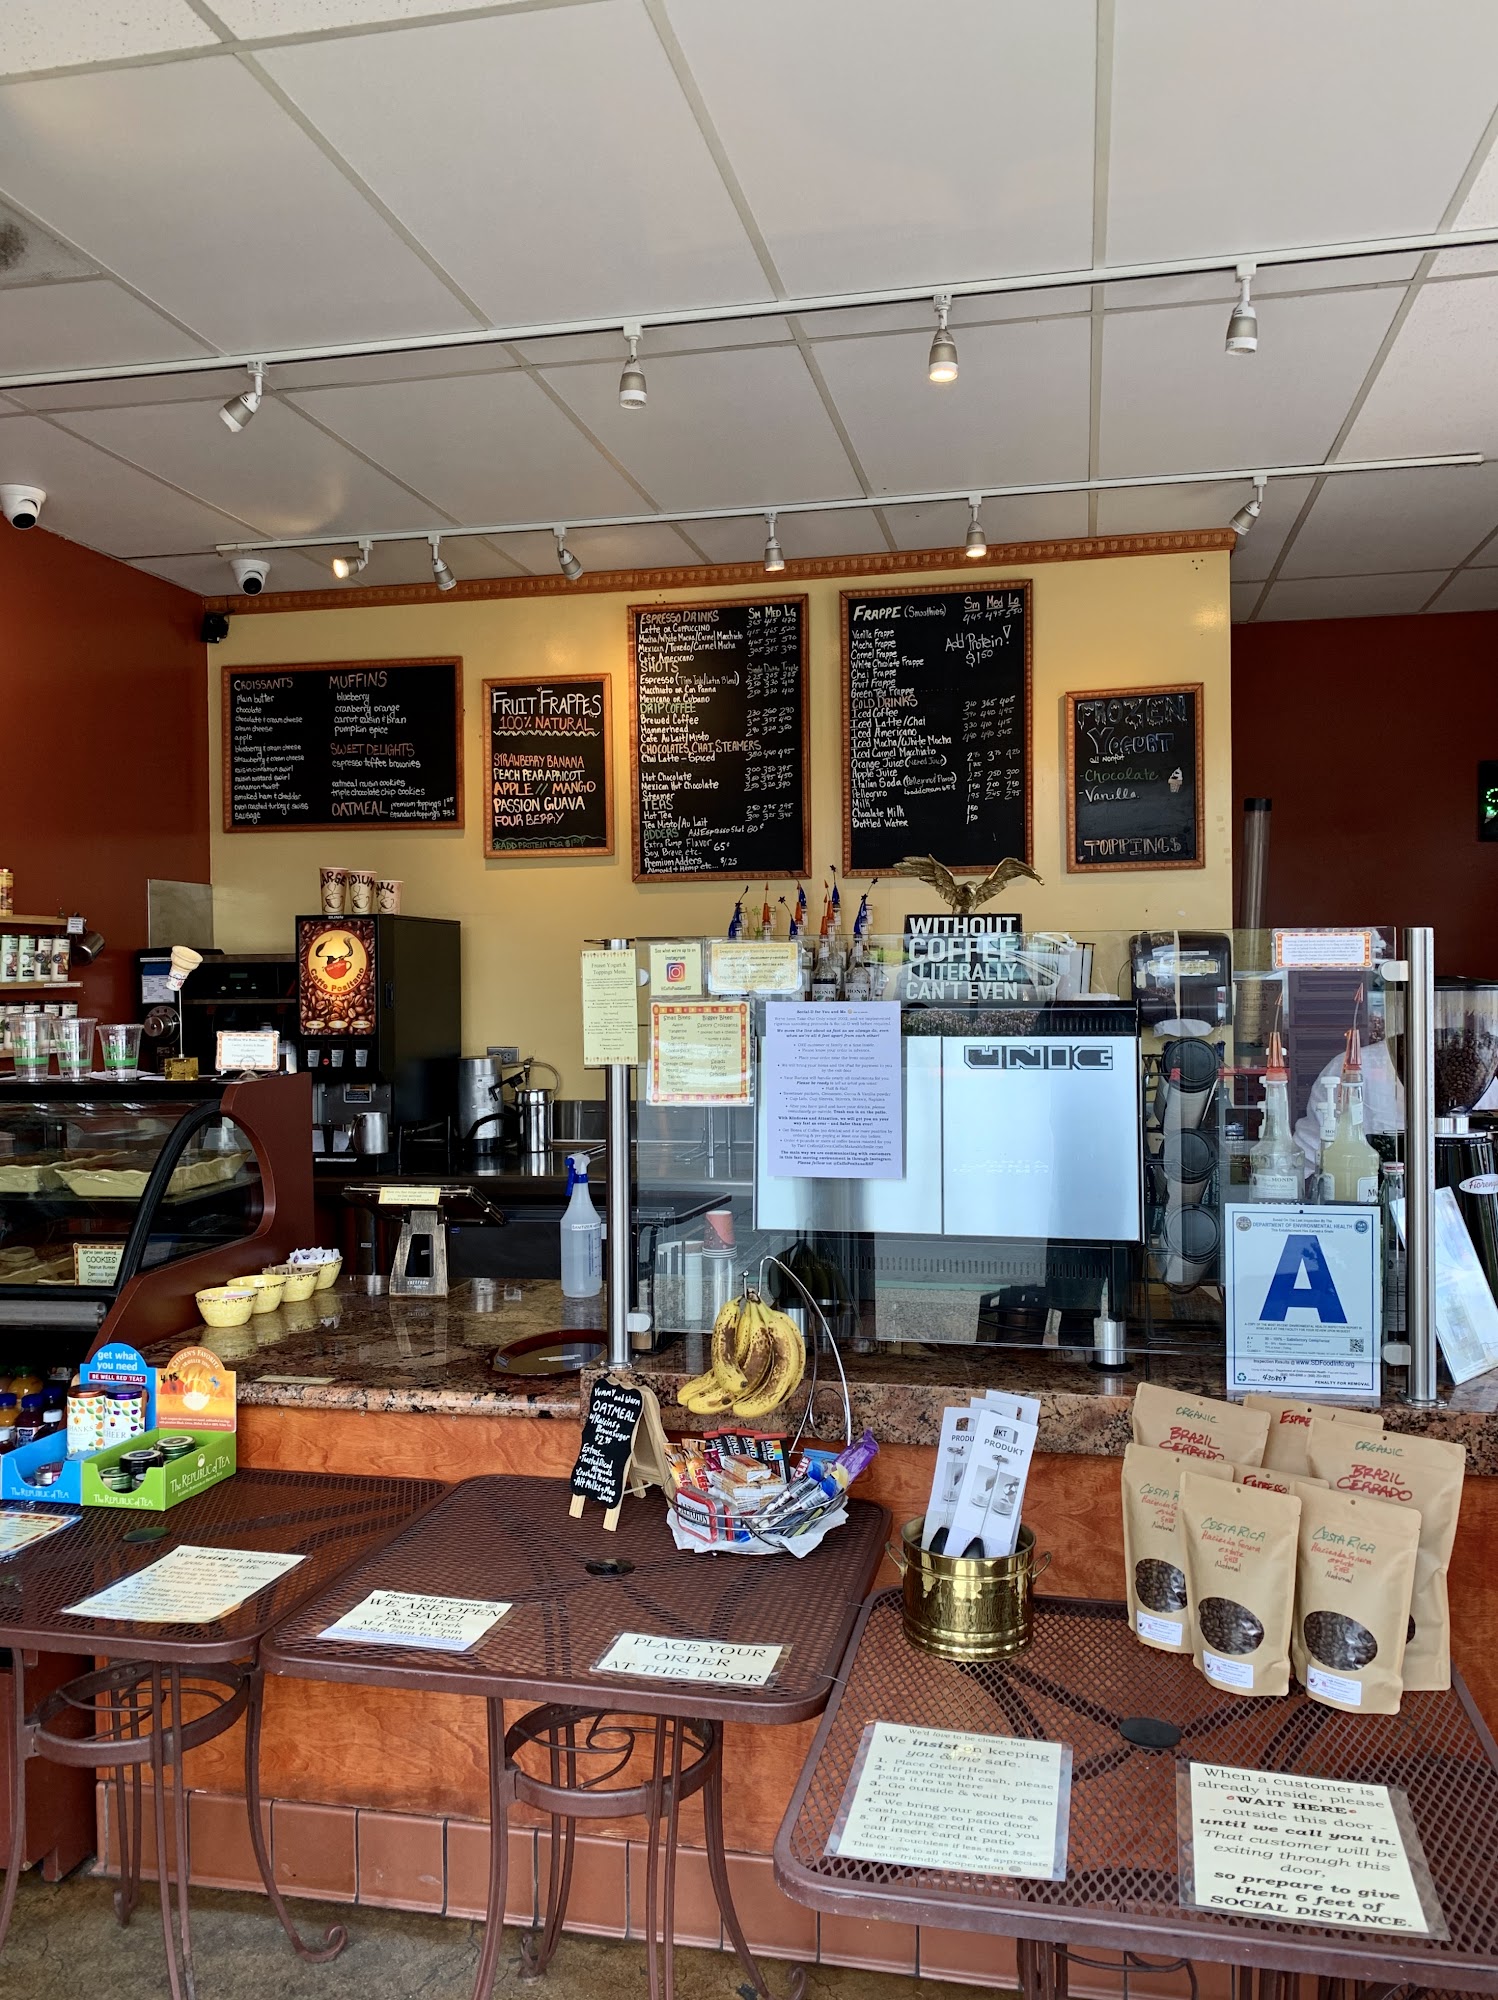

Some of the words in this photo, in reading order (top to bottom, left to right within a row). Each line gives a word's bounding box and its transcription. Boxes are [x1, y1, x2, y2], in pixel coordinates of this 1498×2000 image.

[641, 612, 681, 624] ESPRESSO
[683, 610, 719, 622] DRINKS
[853, 605, 901, 621] FRAPPE
[641, 662, 679, 672] SHOTS
[234, 678, 293, 691] CROISSANTS
[329, 671, 387, 689] MUFFINS
[337, 693, 369, 706] blueberry
[493, 691, 537, 713] FRUIT
[539, 690, 601, 715] FRAPPES
[852, 700, 875, 709] COLD
[878, 695, 918, 707] DRINKS
[335, 705, 371, 715] cranberry
[374, 704, 400, 719] orange
[641, 715, 670, 724] Brewed
[673, 715, 699, 725] Coffee
[872, 710, 898, 718] Coffee
[1077, 696, 1187, 729] FROZEN
[335, 725, 366, 736] pumpkin
[369, 725, 388, 737] spice
[500, 717, 531, 729] 100%
[536, 716, 594, 730] NATURAL
[1087, 727, 1174, 754] YOGURT
[331, 743, 364, 755] SWEET
[367, 743, 415, 757] DELIGHTS
[332, 760, 363, 769] espresso
[365, 759, 387, 767] toffee
[389, 759, 421, 768] brownies
[494, 753, 545, 767] STRAWBERRY
[547, 756, 584, 768] BANANA
[494, 768, 520, 780] PEACH
[522, 769, 544, 781] PEAR
[545, 770, 585, 781] APRICOT
[876, 769, 898, 777] Juice
[494, 782, 533, 795] APPLE
[552, 781, 596, 794] MANGO
[332, 801, 388, 816] OATMEAL
[493, 798, 540, 812] PASSION
[544, 796, 585, 811] GUAVA
[642, 800, 673, 810] TEAS
[887, 805, 905, 817] Milk
[495, 814, 523, 827] FOUR
[526, 812, 564, 825] BERRY
[910, 917, 1016, 936] WITHOUT
[909, 938, 1017, 962] COFFEE
[310, 968, 328, 989] Caffe
[331, 967, 364, 992] Positano
[908, 964, 912, 980] I
[915, 963, 1017, 980] LITERALLY
[907, 982, 962, 999] CAN'T
[970, 982, 1017, 999] EVEN
[964, 1045, 1113, 1070] UNIC
[1259, 1234, 1348, 1323] A
[98, 1351, 112, 1362] get
[115, 1350, 137, 1360] what
[197, 1350, 219, 1369] FAVORITE
[97, 1362, 113, 1371] you
[116, 1362, 137, 1371] need
[593, 1400, 635, 1422] OATMEAL
[1176, 1406, 1219, 1424] ORGANIC
[1169, 1427, 1220, 1450] BRAZIL
[765, 1440, 775, 1460] KIND
[984, 1439, 1025, 1456] PRODUKT
[1355, 1441, 1405, 1457] ORGANIC
[1351, 1464, 1405, 1485] BRAZIL
[1337, 1478, 1412, 1501] CERRADO
[141, 1498, 153, 1506] TEA
[1201, 1517, 1237, 1534] COSTA
[1312, 1526, 1345, 1546] COSTA
[369, 1598, 400, 1608] WE
[402, 1603, 443, 1612] ARE
[448, 1607, 503, 1618] OPEN
[408, 1611, 464, 1621] SAFE!
[634, 1638, 699, 1652] PLACE
[708, 1646, 766, 1657] YOUR
[654, 1654, 730, 1667] ORDER
[607, 1661, 635, 1669] AT
[642, 1664, 689, 1675] THIS
[698, 1670, 762, 1682] DOOR
[884, 1735, 906, 1745] We
[913, 1739, 958, 1750] insist
[963, 1745, 982, 1754] on
[989, 1747, 1050, 1762] keeping
[895, 1759, 925, 1767] Place
[968, 1767, 995, 1775] Here
[906, 1750, 935, 1760] you
[958, 1755, 981, 1763] me
[985, 1759, 1020, 1768] safe.
[1204, 1768, 1251, 1781] When
[1274, 1778, 1354, 1793] customer
[1361, 1787, 1374, 1796] is
[1198, 1781, 1259, 1795] already
[1266, 1787, 1323, 1802] inside,
[1330, 1796, 1384, 1808] please
[1238, 1796, 1286, 1807] WAIT
[1293, 1803, 1347, 1814] HERE
[1223, 1808, 1287, 1821] outside
[1293, 1815, 1327, 1825] this
[1334, 1819, 1372, 1830] door
[1200, 1818, 1246, 1828] until
[1286, 1826, 1322, 1837] call
[1329, 1833, 1363, 1842] you
[1371, 1836, 1396, 1845] in.
[1204, 1830, 1243, 1841] That
[1250, 1836, 1331, 1851] customer
[1337, 1845, 1370, 1856] will
[1377, 1850, 1397, 1859] be
[1214, 1845, 1273, 1859] exiting
[1280, 1853, 1350, 1868] through
[1357, 1861, 1390, 1871] this
[1280, 1864, 1326, 1878] door,
[1214, 1872, 1235, 1880] so
[1241, 1875, 1323, 1891] prepare
[1330, 1885, 1351, 1894] to
[1358, 1889, 1400, 1900] give
[1235, 1886, 1287, 1900] them
[1296, 1894, 1308, 1902] 6
[1314, 1896, 1355, 1908] feet
[1363, 1902, 1384, 1912] of
[1210, 1895, 1288, 1913] SOCIAL
[1296, 1906, 1412, 1928] DISTANCE.
